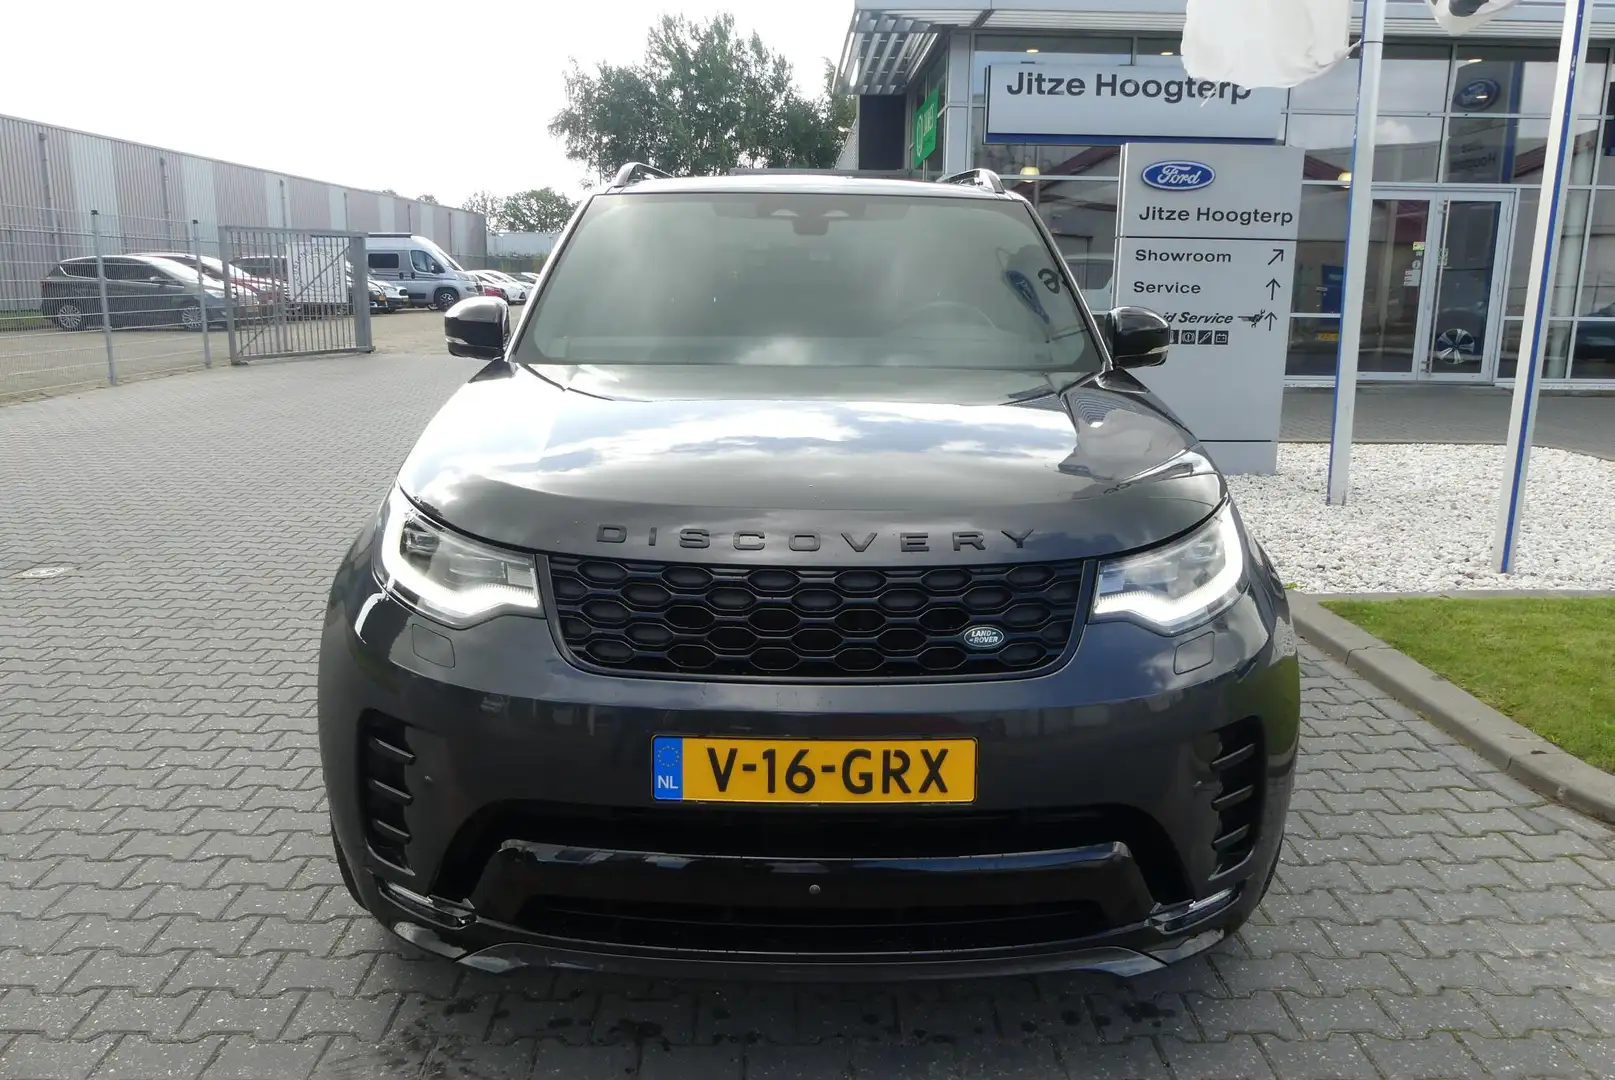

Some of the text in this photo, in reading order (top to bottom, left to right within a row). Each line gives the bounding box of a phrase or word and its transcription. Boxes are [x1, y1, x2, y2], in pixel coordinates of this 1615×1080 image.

[1006, 71, 1086, 97] Jitze
[1156, 165, 1201, 184] Ford
[1139, 206, 1293, 226] Jitze Hoogterp
[1135, 249, 1232, 263] Showroom
[1133, 281, 1201, 294] Service
[1178, 311, 1234, 324] Service
[596, 524, 1034, 552] DISCOVERY
[706, 747, 949, 794] V-16-GRX
[657, 775, 679, 790] NL
